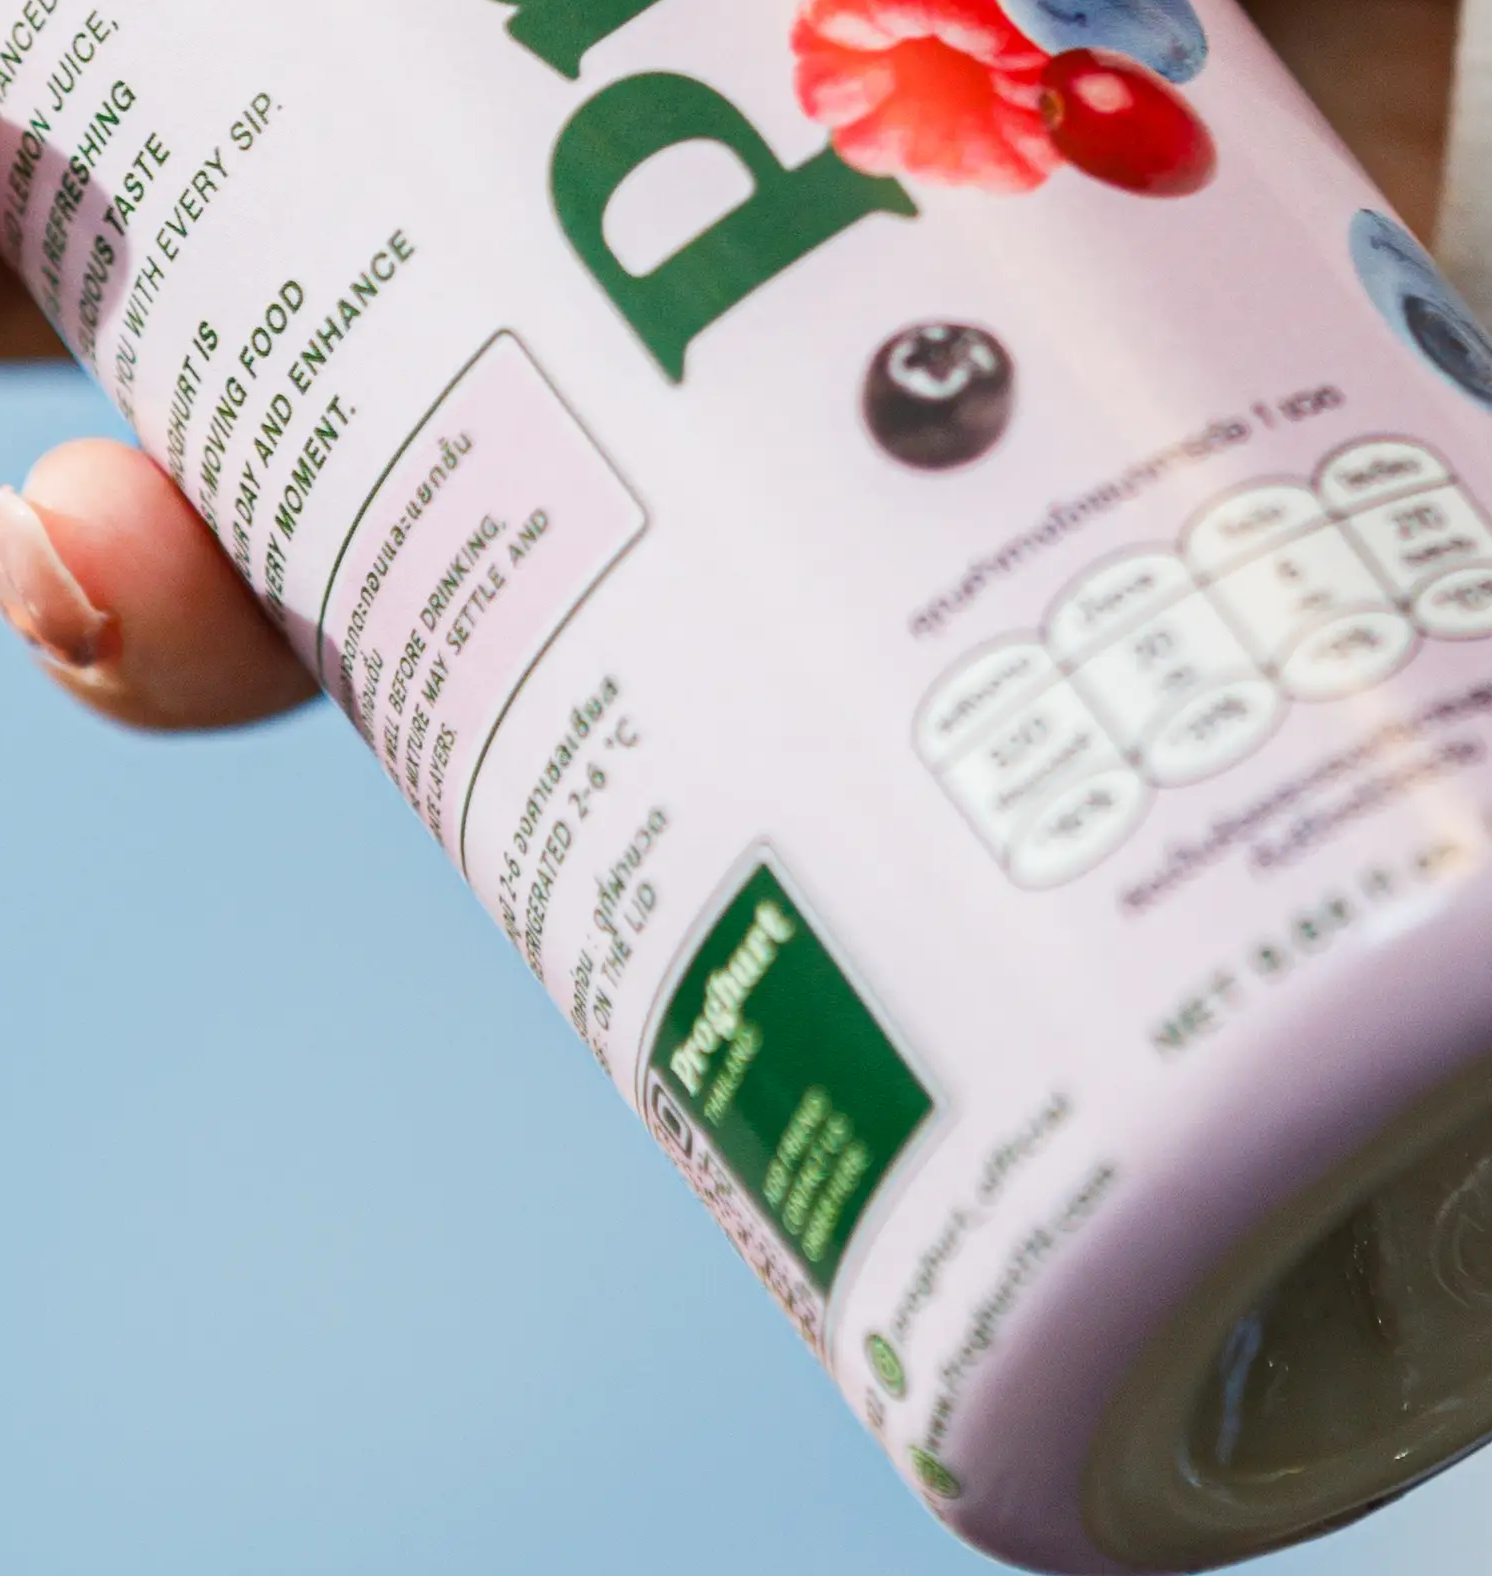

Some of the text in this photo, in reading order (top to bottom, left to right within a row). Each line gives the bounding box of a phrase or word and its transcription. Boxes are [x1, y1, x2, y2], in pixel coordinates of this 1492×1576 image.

[10, 108, 52, 218] LEMON
[46, 9, 120, 112] JUICE,
[229, 91, 283, 152] SIP.
[41, 79, 137, 268] REFRESHING
[103, 132, 171, 237] TASTE
[155, 146, 229, 264] EVERY
[123, 255, 166, 340] WITH
[192, 320, 220, 364] IS
[238, 279, 305, 381] FOOD
[114, 335, 138, 392] YOU
[231, 461, 261, 527] DAY
[255, 392, 293, 469] AND
[287, 228, 417, 397] ENHANCE
[273, 393, 357, 543] MOMENT.
[419, 512, 508, 633] DRINKING,
[387, 628, 427, 717] BEFORE
[403, 702, 431, 786] MIXTURE
[421, 652, 451, 710] MAY
[445, 563, 506, 655] SETTLE
[505, 506, 553, 569] AND
[383, 719, 402, 764] WELL
[432, 721, 459, 805] LAYERS.
[568, 761, 608, 824] 2-6
[605, 714, 643, 753] °C
[499, 851, 523, 904] 2-6
[623, 881, 659, 935] LID
[599, 938, 635, 992] THE
[670, 898, 796, 1098] Proghurt
[592, 997, 615, 1032] ON
